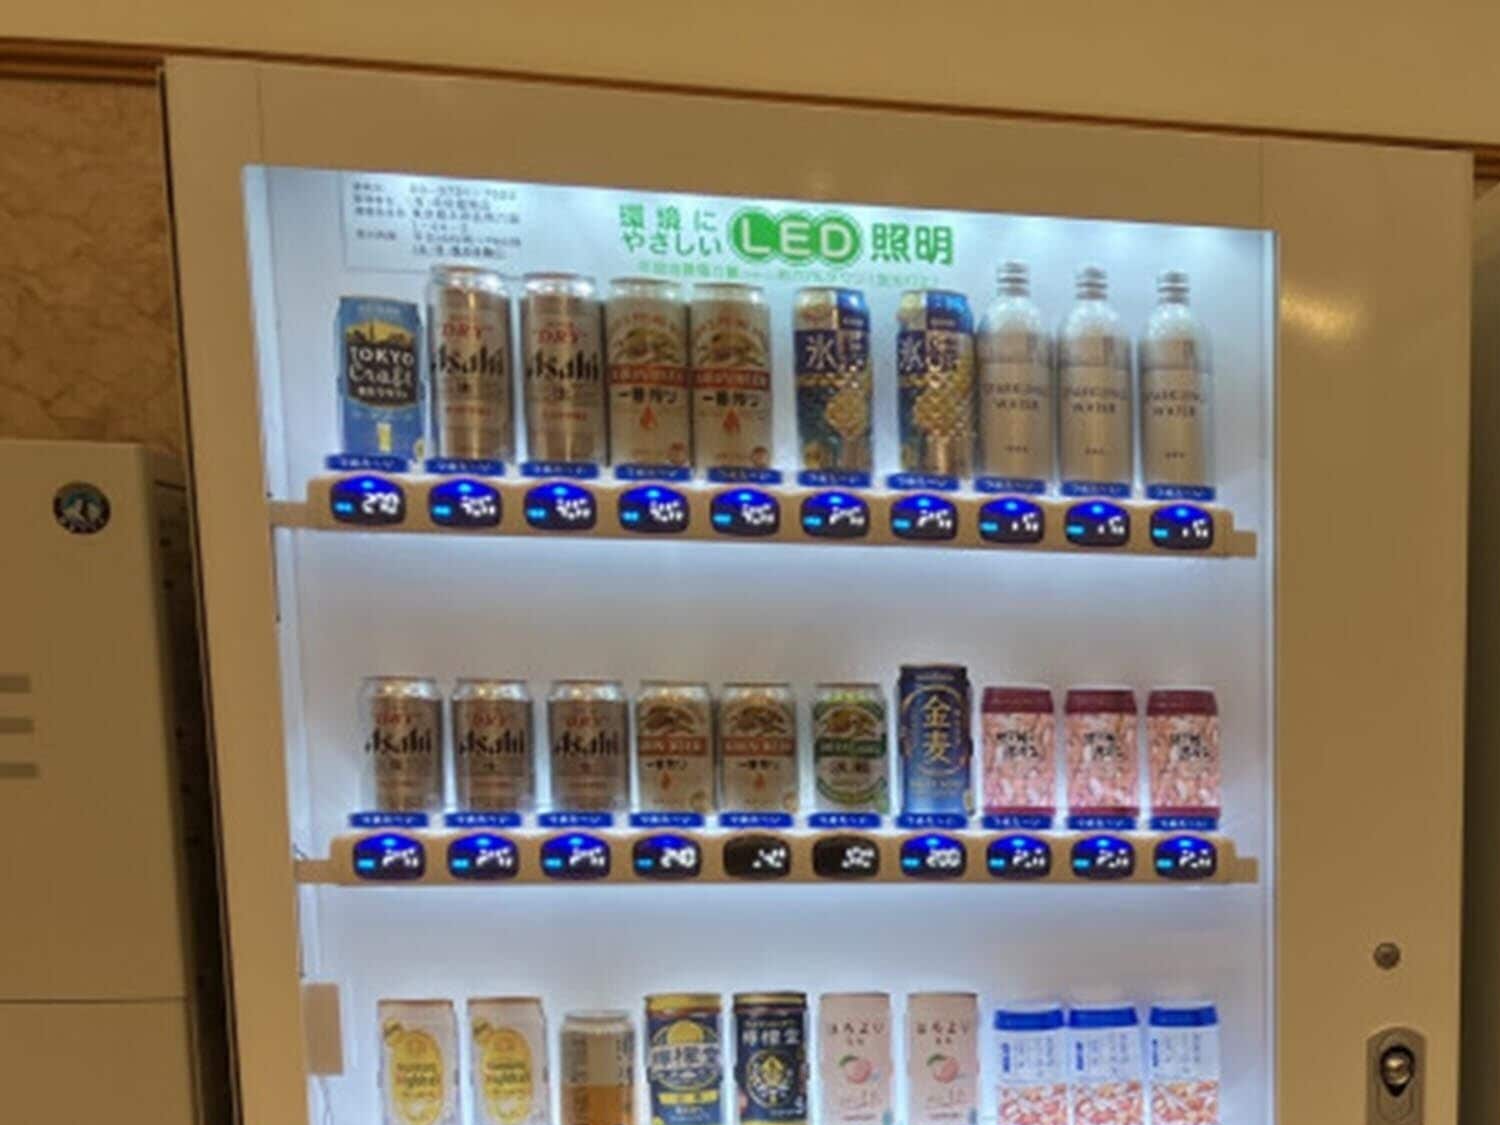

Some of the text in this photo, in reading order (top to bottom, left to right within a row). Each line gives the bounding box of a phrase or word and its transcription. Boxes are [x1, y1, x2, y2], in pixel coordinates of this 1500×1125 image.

[618, 204, 720, 233] 環境に
[623, 232, 723, 257] やさしい
[738, 215, 956, 267] LED 照明
[351, 347, 415, 367] TOKYO
[922, 695, 951, 765] 金麦
